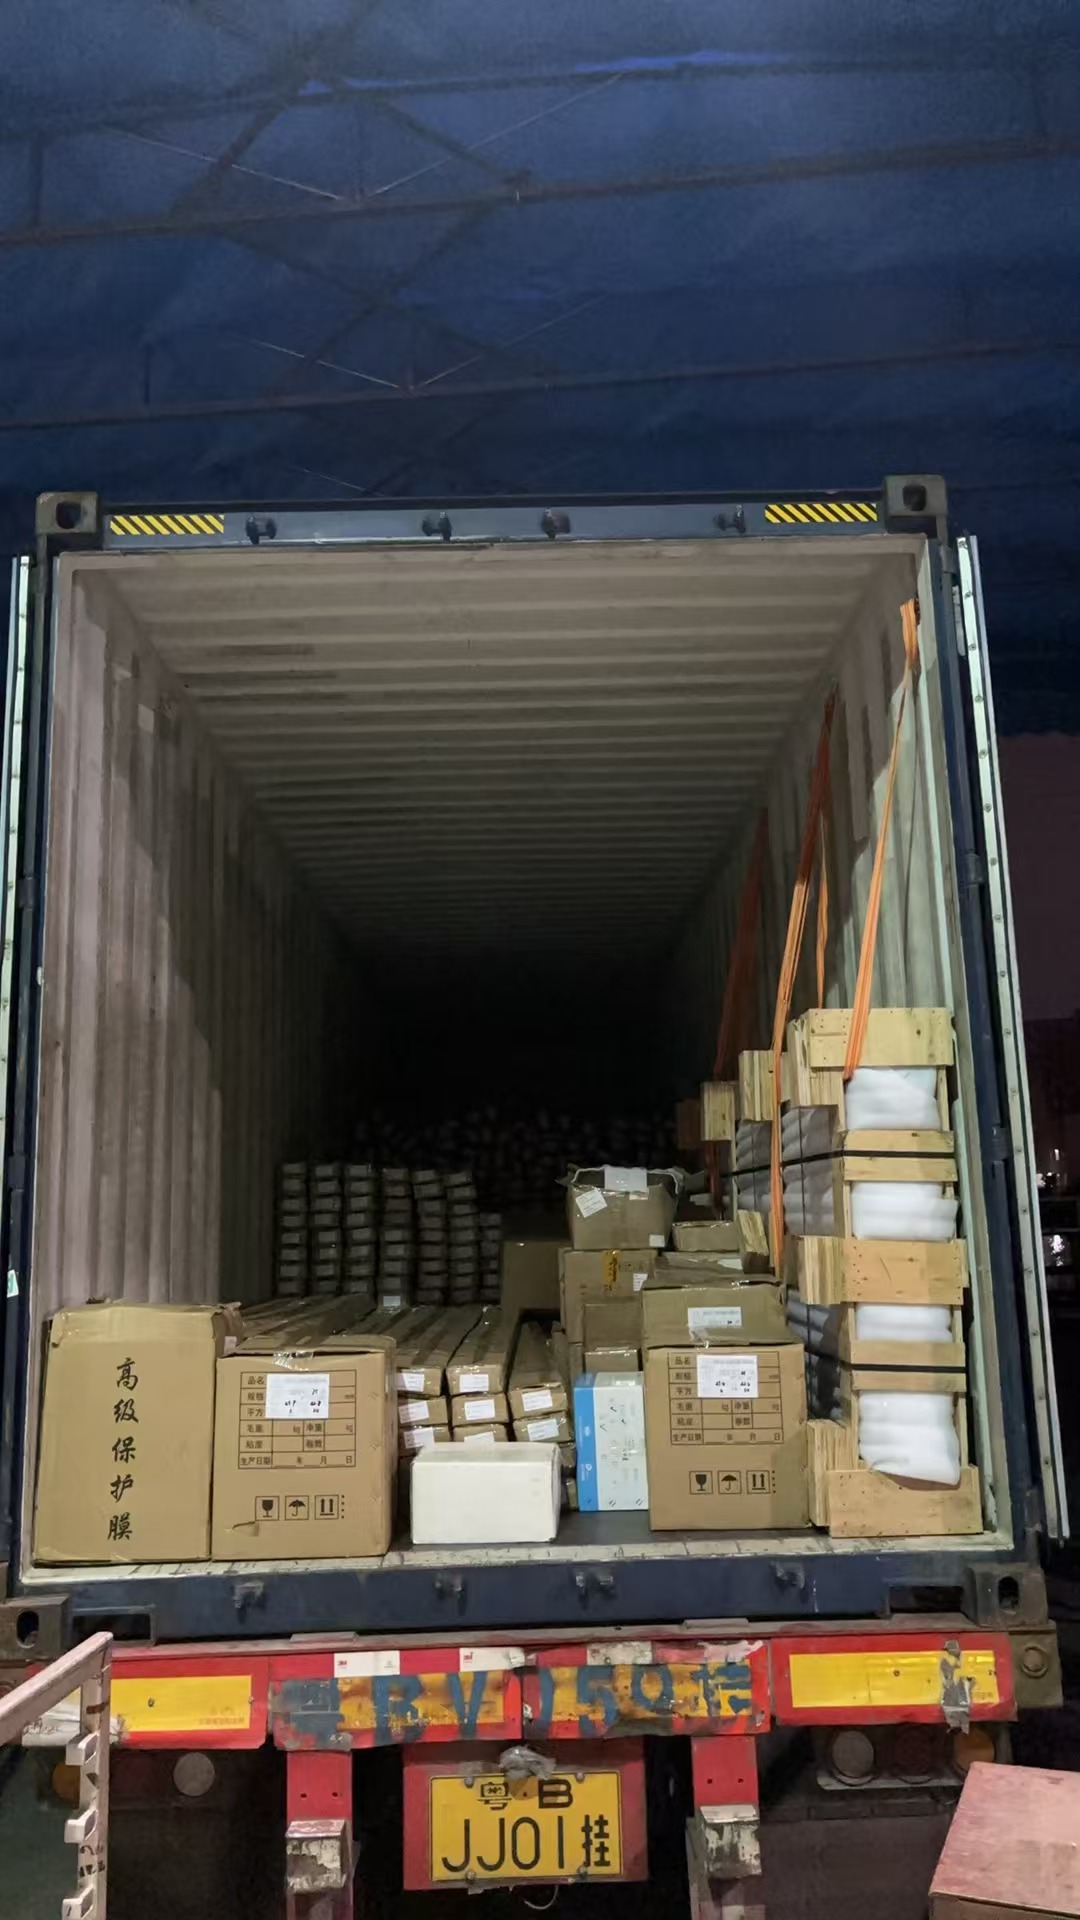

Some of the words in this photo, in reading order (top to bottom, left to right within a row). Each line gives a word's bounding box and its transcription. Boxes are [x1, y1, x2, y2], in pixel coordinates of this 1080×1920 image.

[107, 1357, 139, 1541] 高级保护膜
